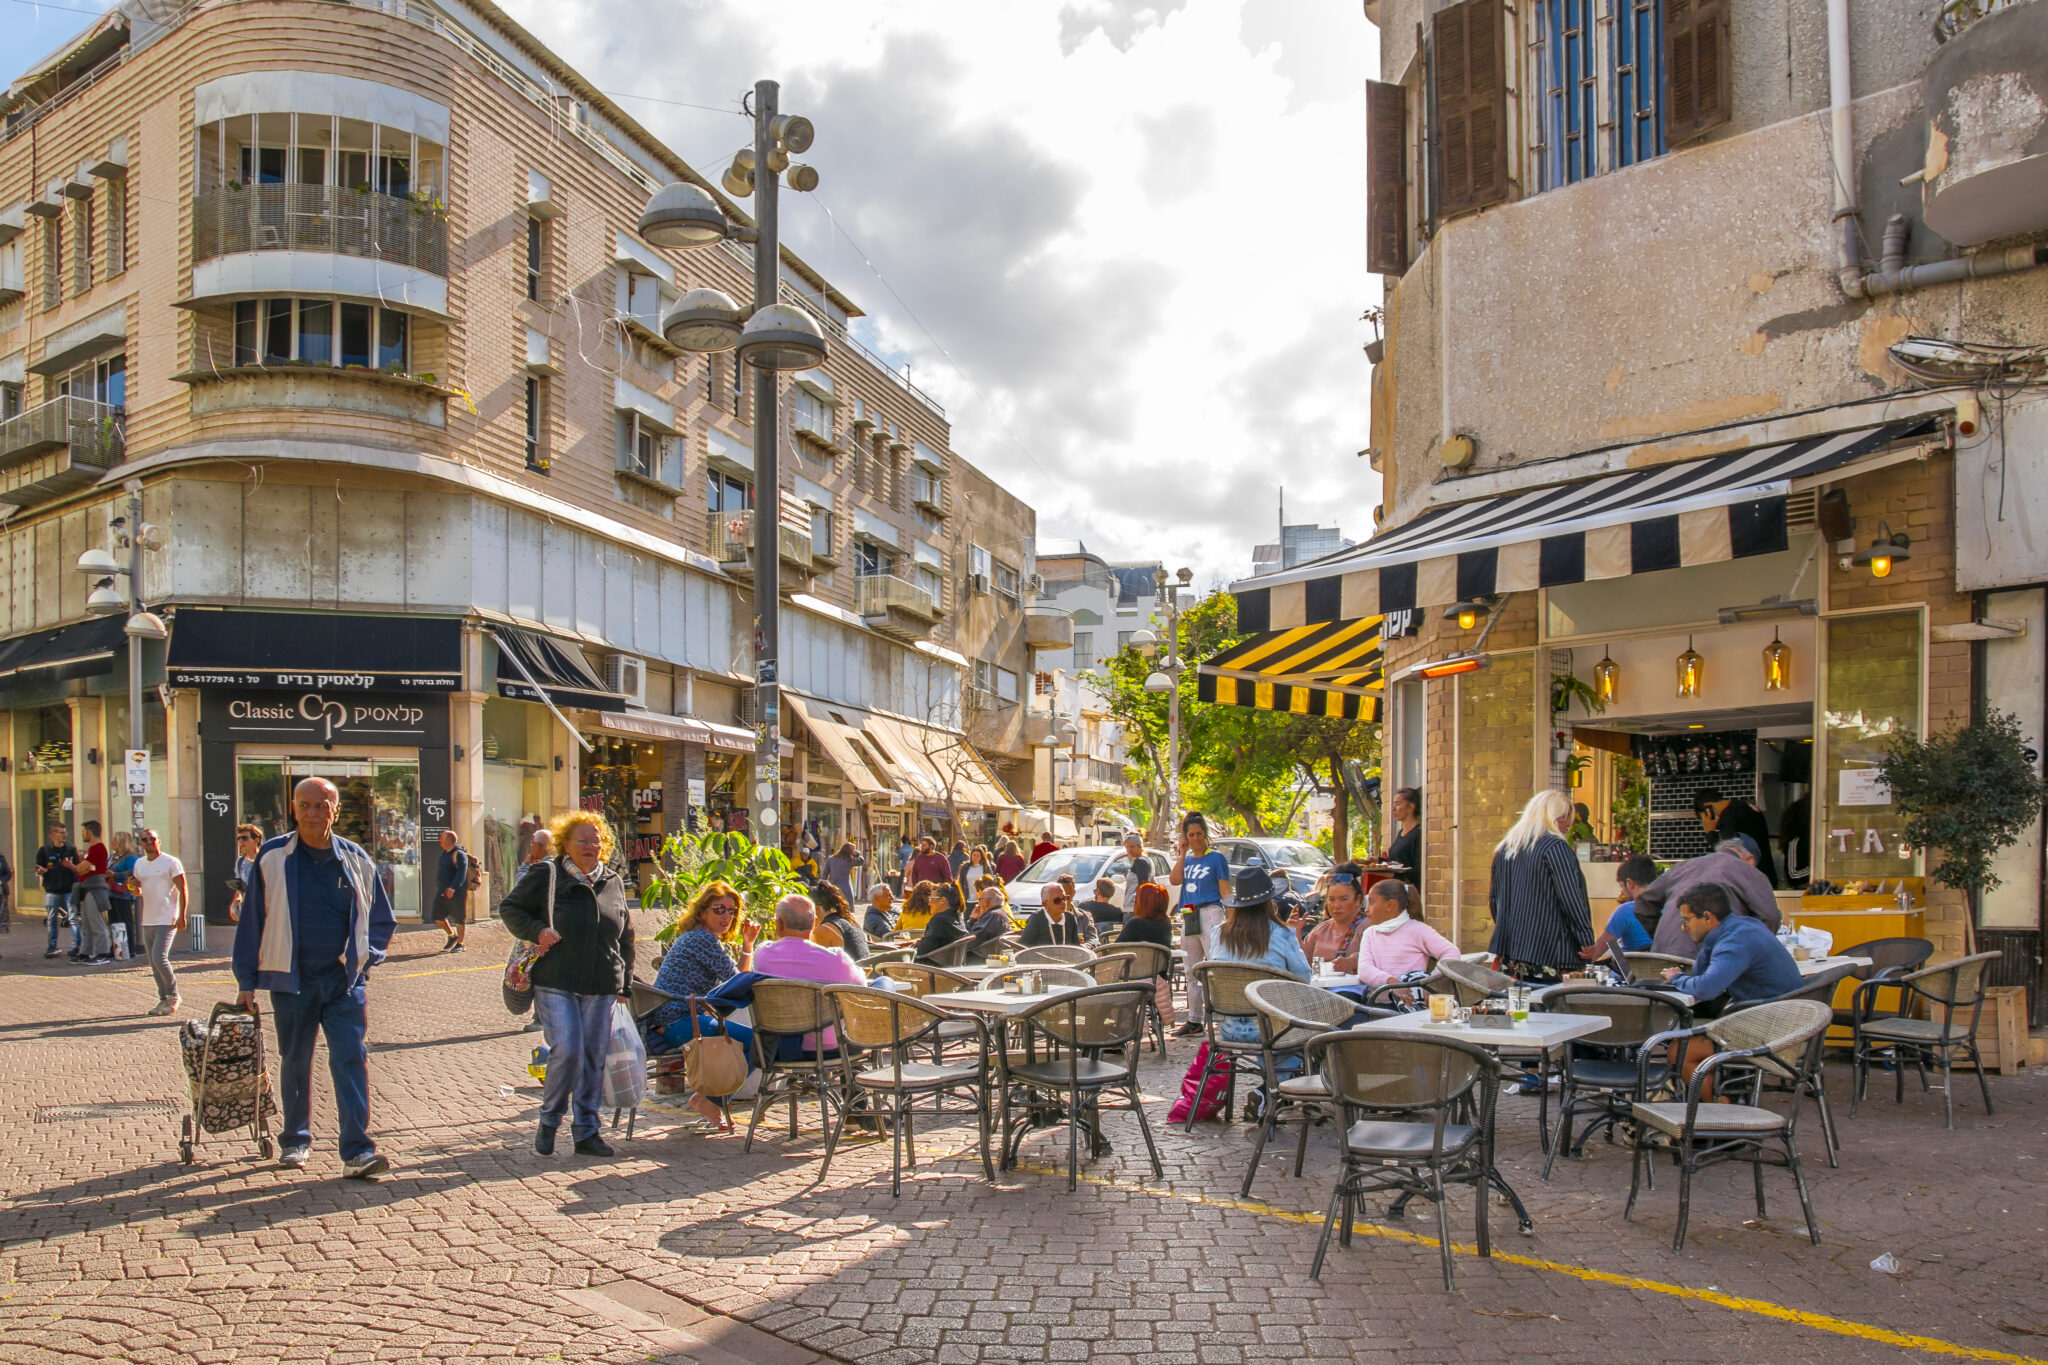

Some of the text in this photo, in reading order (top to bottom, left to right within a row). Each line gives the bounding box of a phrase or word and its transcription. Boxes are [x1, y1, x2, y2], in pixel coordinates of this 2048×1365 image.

[177, 675, 235, 683] 03-5177974
[277, 673, 375, 688] קלאסיק בדים
[228, 700, 295, 719] Classic
[354, 704, 424, 725] קלאסיק
[205, 792, 231, 801] Classic
[423, 797, 447, 805] Classic
[625, 836, 660, 860] SALE
